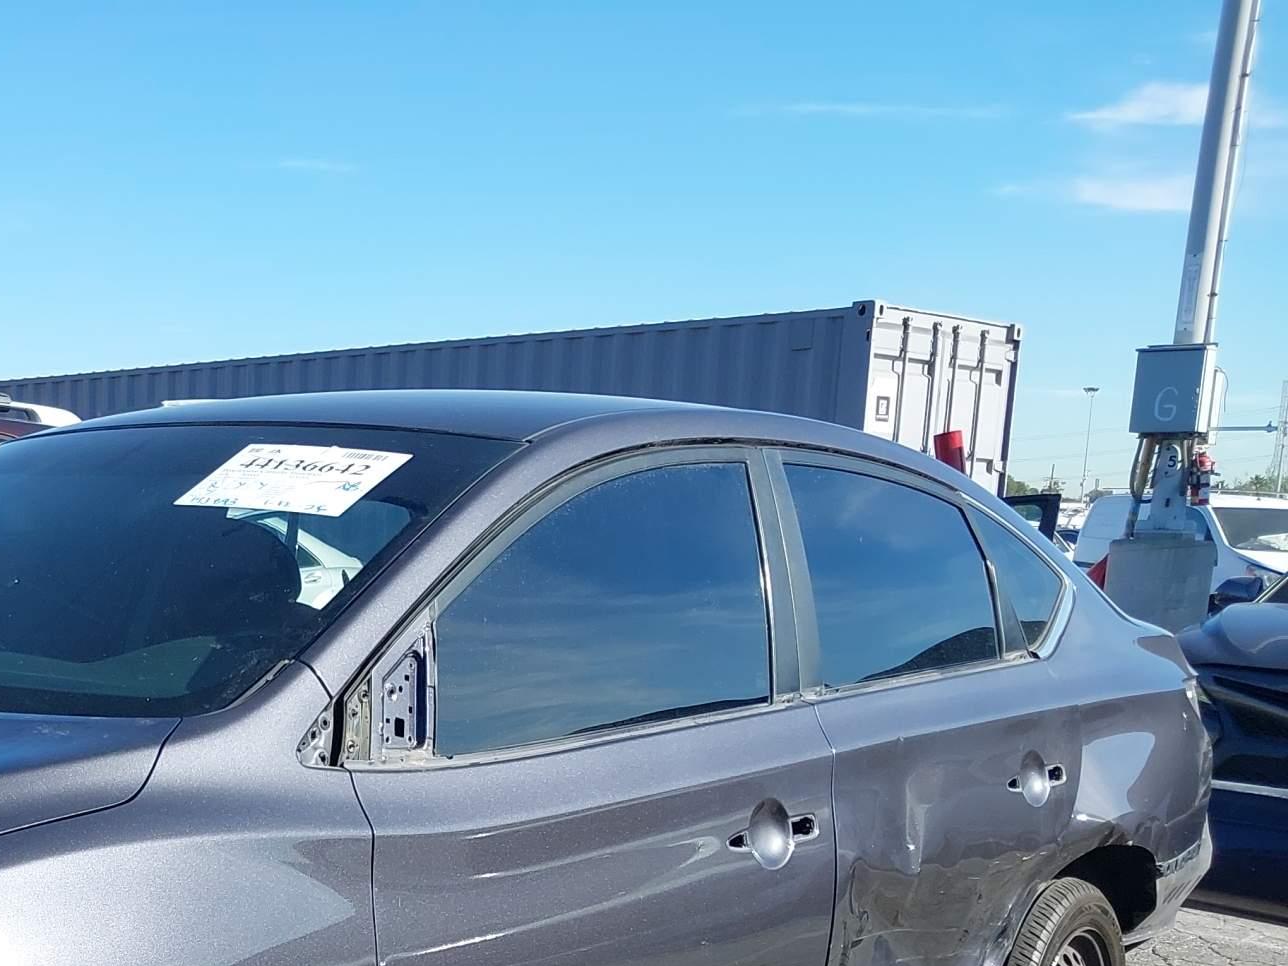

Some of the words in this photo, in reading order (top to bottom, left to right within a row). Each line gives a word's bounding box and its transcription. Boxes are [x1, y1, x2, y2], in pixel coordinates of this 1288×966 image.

[1153, 386, 1179, 422] G
[239, 457, 372, 476] 44136642
[1167, 455, 1177, 468] 5
